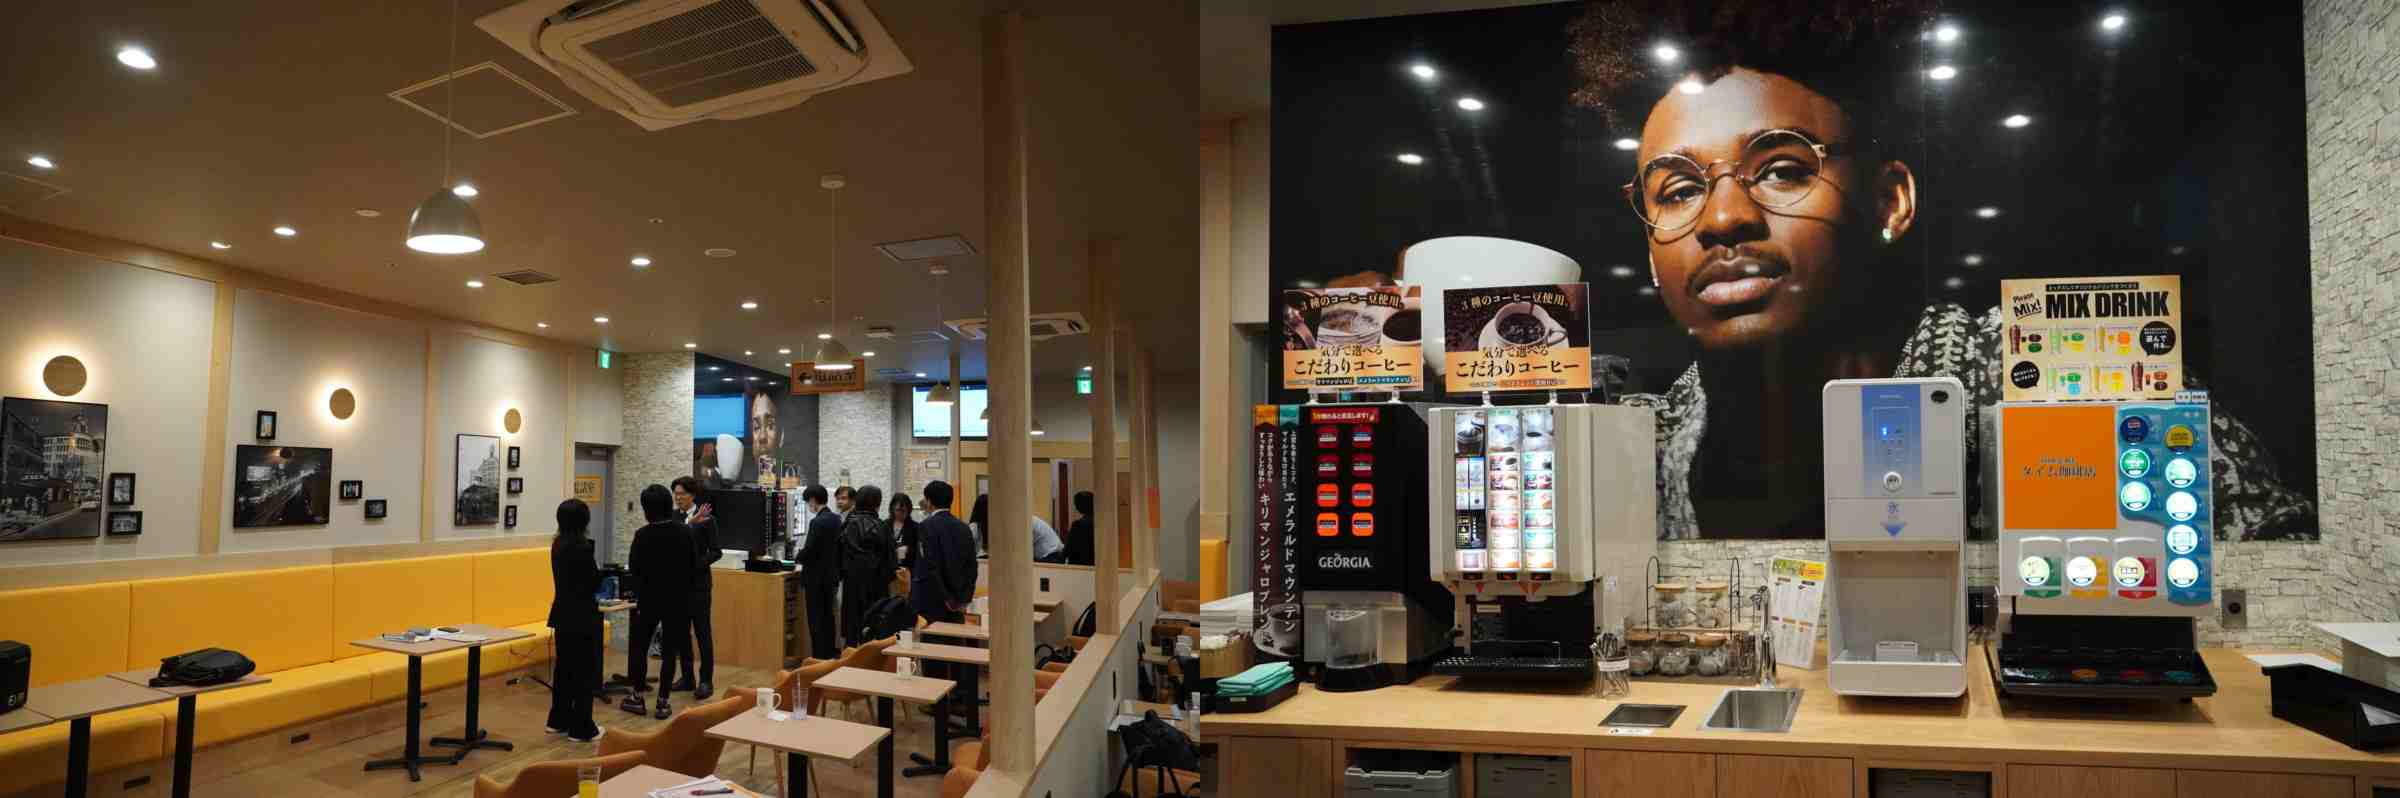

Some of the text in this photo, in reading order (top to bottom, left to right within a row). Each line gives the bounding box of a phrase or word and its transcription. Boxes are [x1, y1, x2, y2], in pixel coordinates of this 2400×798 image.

[2046, 291, 2170, 318] MIX DRINK
[1320, 344, 1383, 357] 気分で選べる
[1482, 345, 1549, 358] 気分で選べる
[1294, 358, 1412, 375] こだわりコーヒー
[1456, 360, 1579, 378] こだわりコーヒー
[1284, 492, 1296, 632] エメラルドマウンテン
[1318, 554, 1371, 568] GEORGIA
